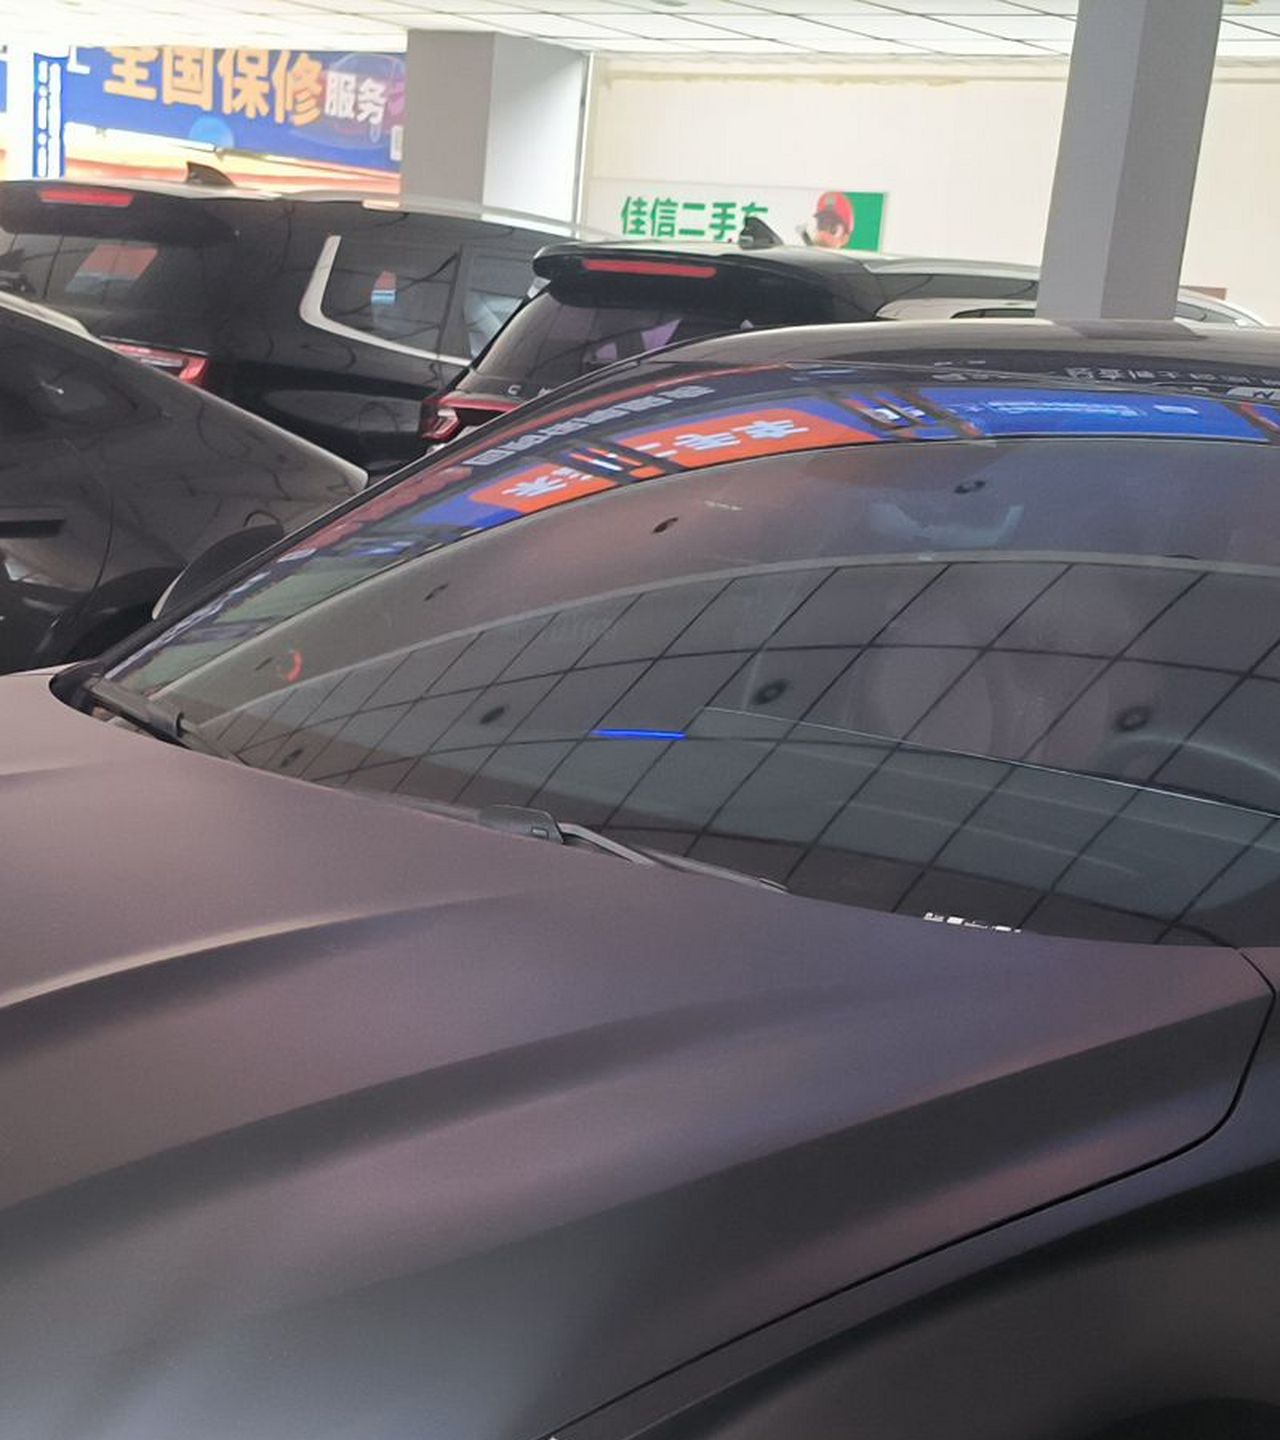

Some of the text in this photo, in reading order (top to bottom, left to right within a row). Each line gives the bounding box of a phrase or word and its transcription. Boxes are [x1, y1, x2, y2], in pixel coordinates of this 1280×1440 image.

[102, 46, 322, 126] 全国保修
[323, 71, 388, 125] 服务
